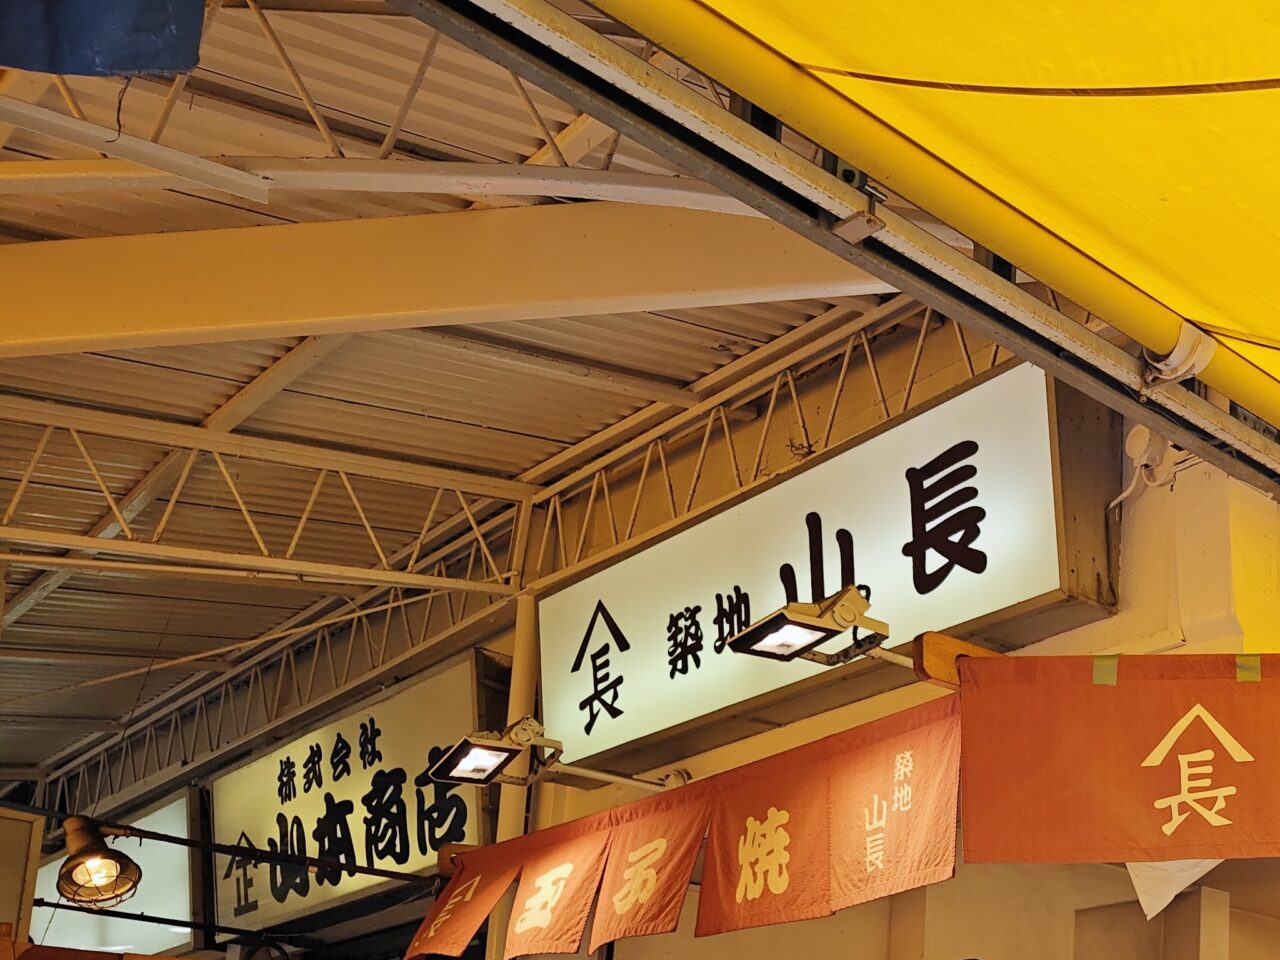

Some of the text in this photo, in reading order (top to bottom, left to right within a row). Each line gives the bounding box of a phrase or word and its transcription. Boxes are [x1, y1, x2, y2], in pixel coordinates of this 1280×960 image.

[666, 585, 751, 680] 築地
[277, 717, 383, 805] 株式会社
[892, 751, 914, 811] 築地
[864, 794, 887, 873] 山長
